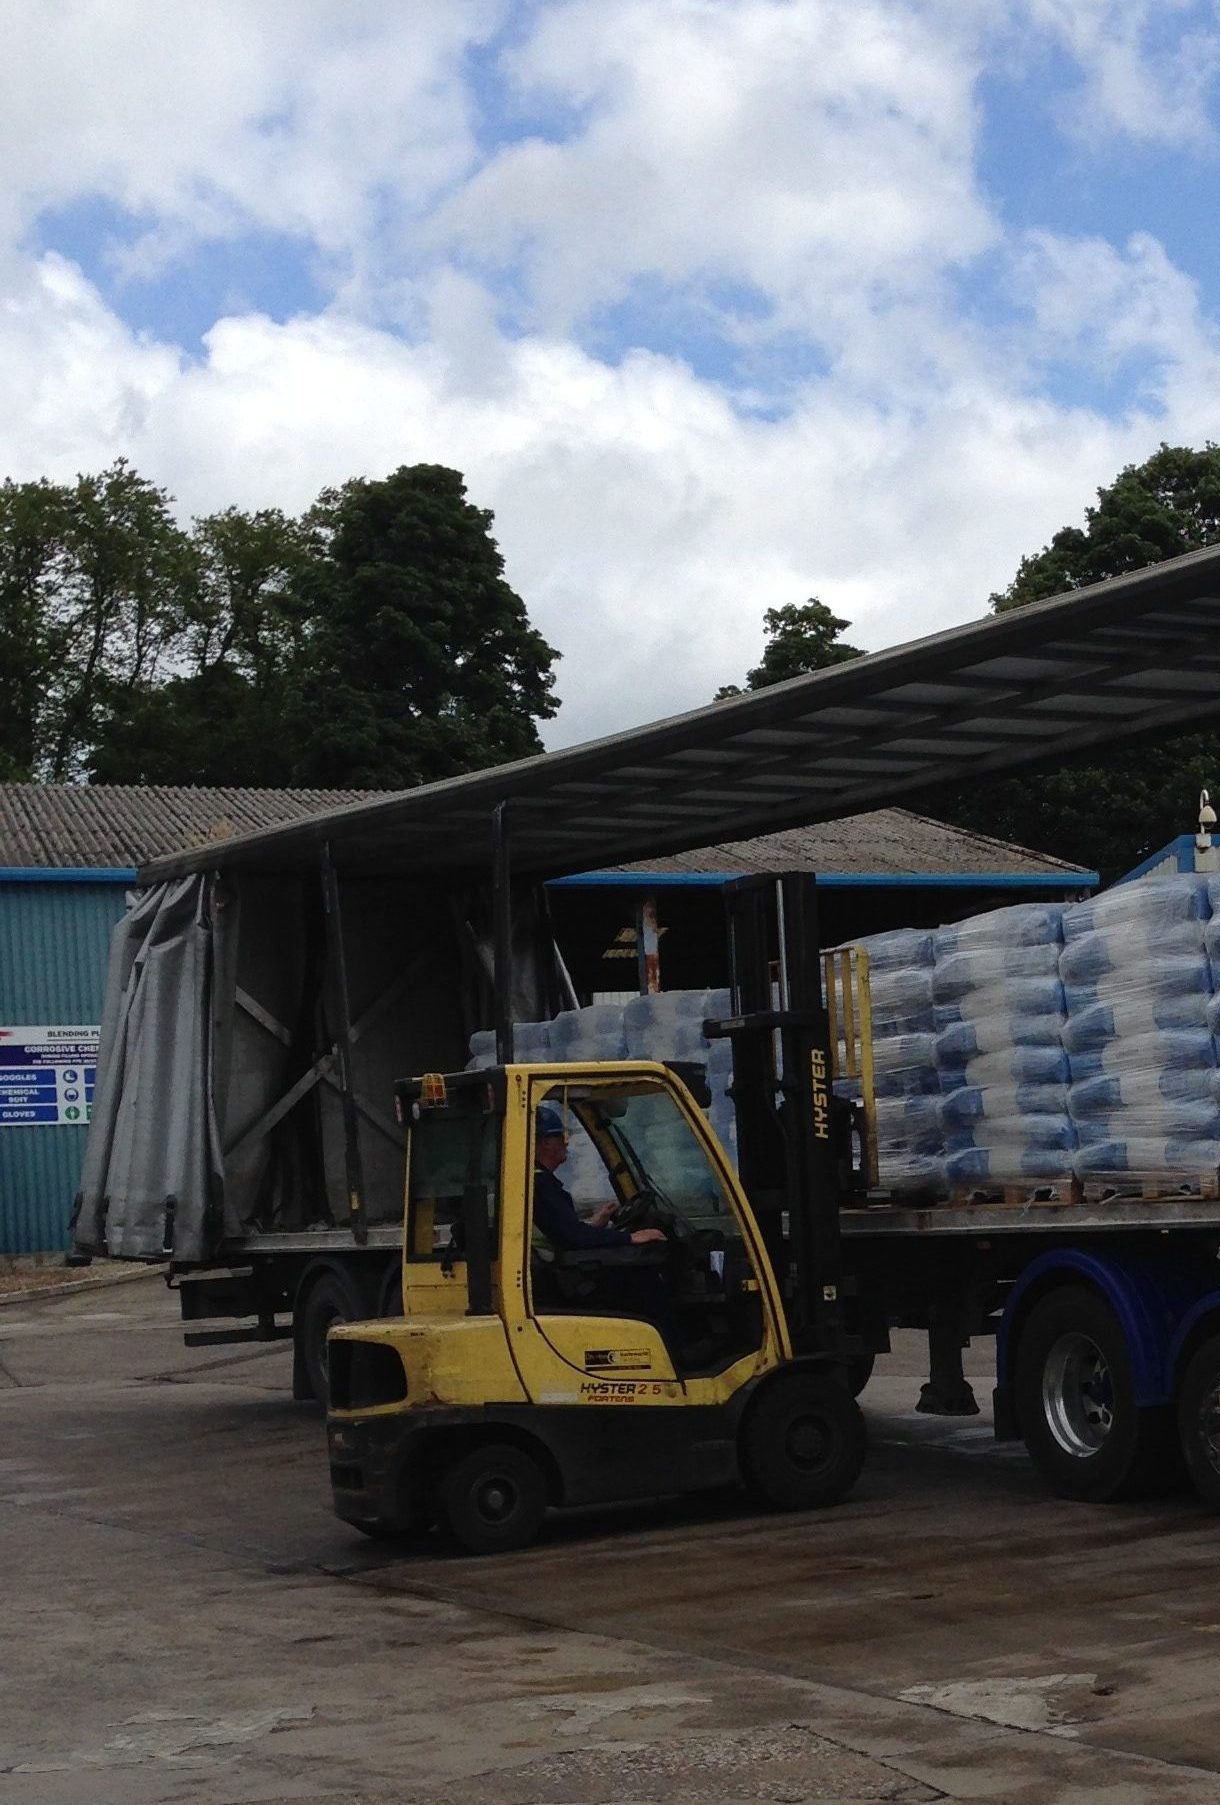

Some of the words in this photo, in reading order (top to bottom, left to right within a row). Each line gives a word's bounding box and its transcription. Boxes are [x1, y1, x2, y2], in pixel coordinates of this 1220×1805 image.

[24, 1045, 76, 1053] CORROSIVE
[811, 1048, 829, 1139] HYSTER
[2, 1110, 36, 1118] GLOVES
[580, 1382, 636, 1395] HYSTER
